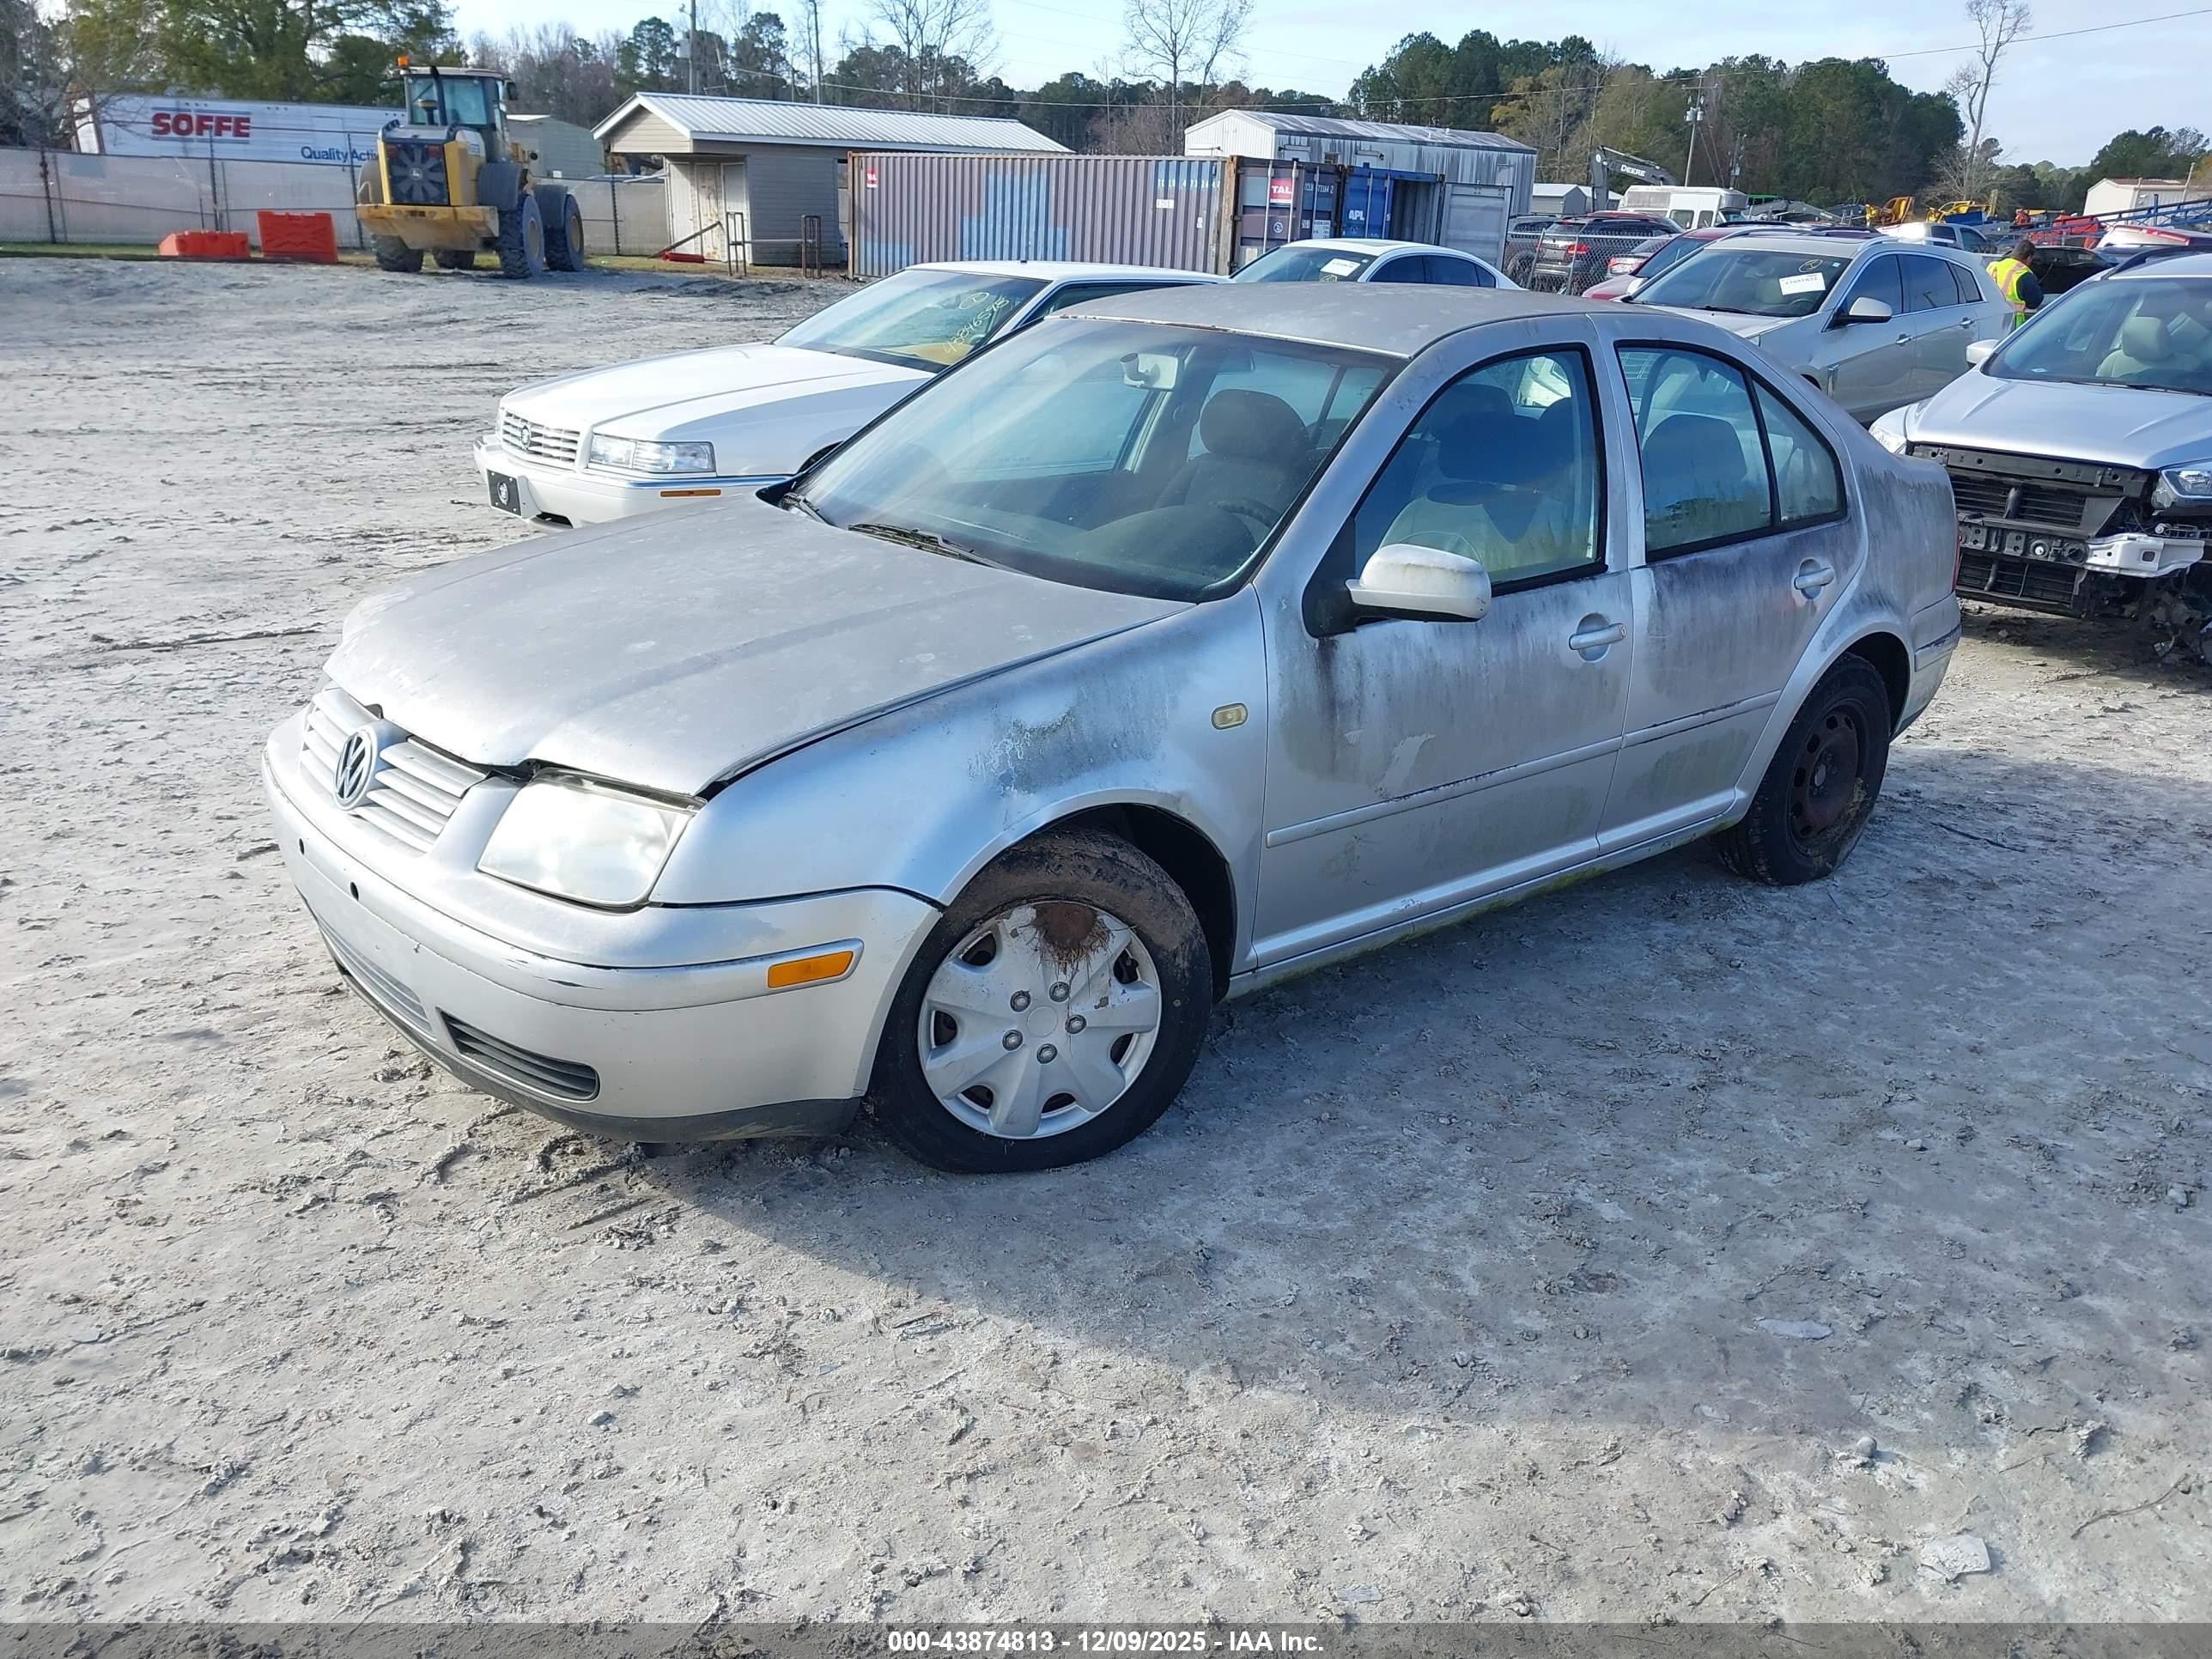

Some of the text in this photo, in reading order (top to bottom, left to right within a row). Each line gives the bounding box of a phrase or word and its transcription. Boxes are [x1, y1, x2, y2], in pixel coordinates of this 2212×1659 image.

[151, 112, 251, 138] SOFFE
[301, 146, 348, 163] Quality
[1620, 164, 1647, 177] DEERE
[1271, 185, 1291, 194] TAL
[1348, 210, 1364, 221] APL
